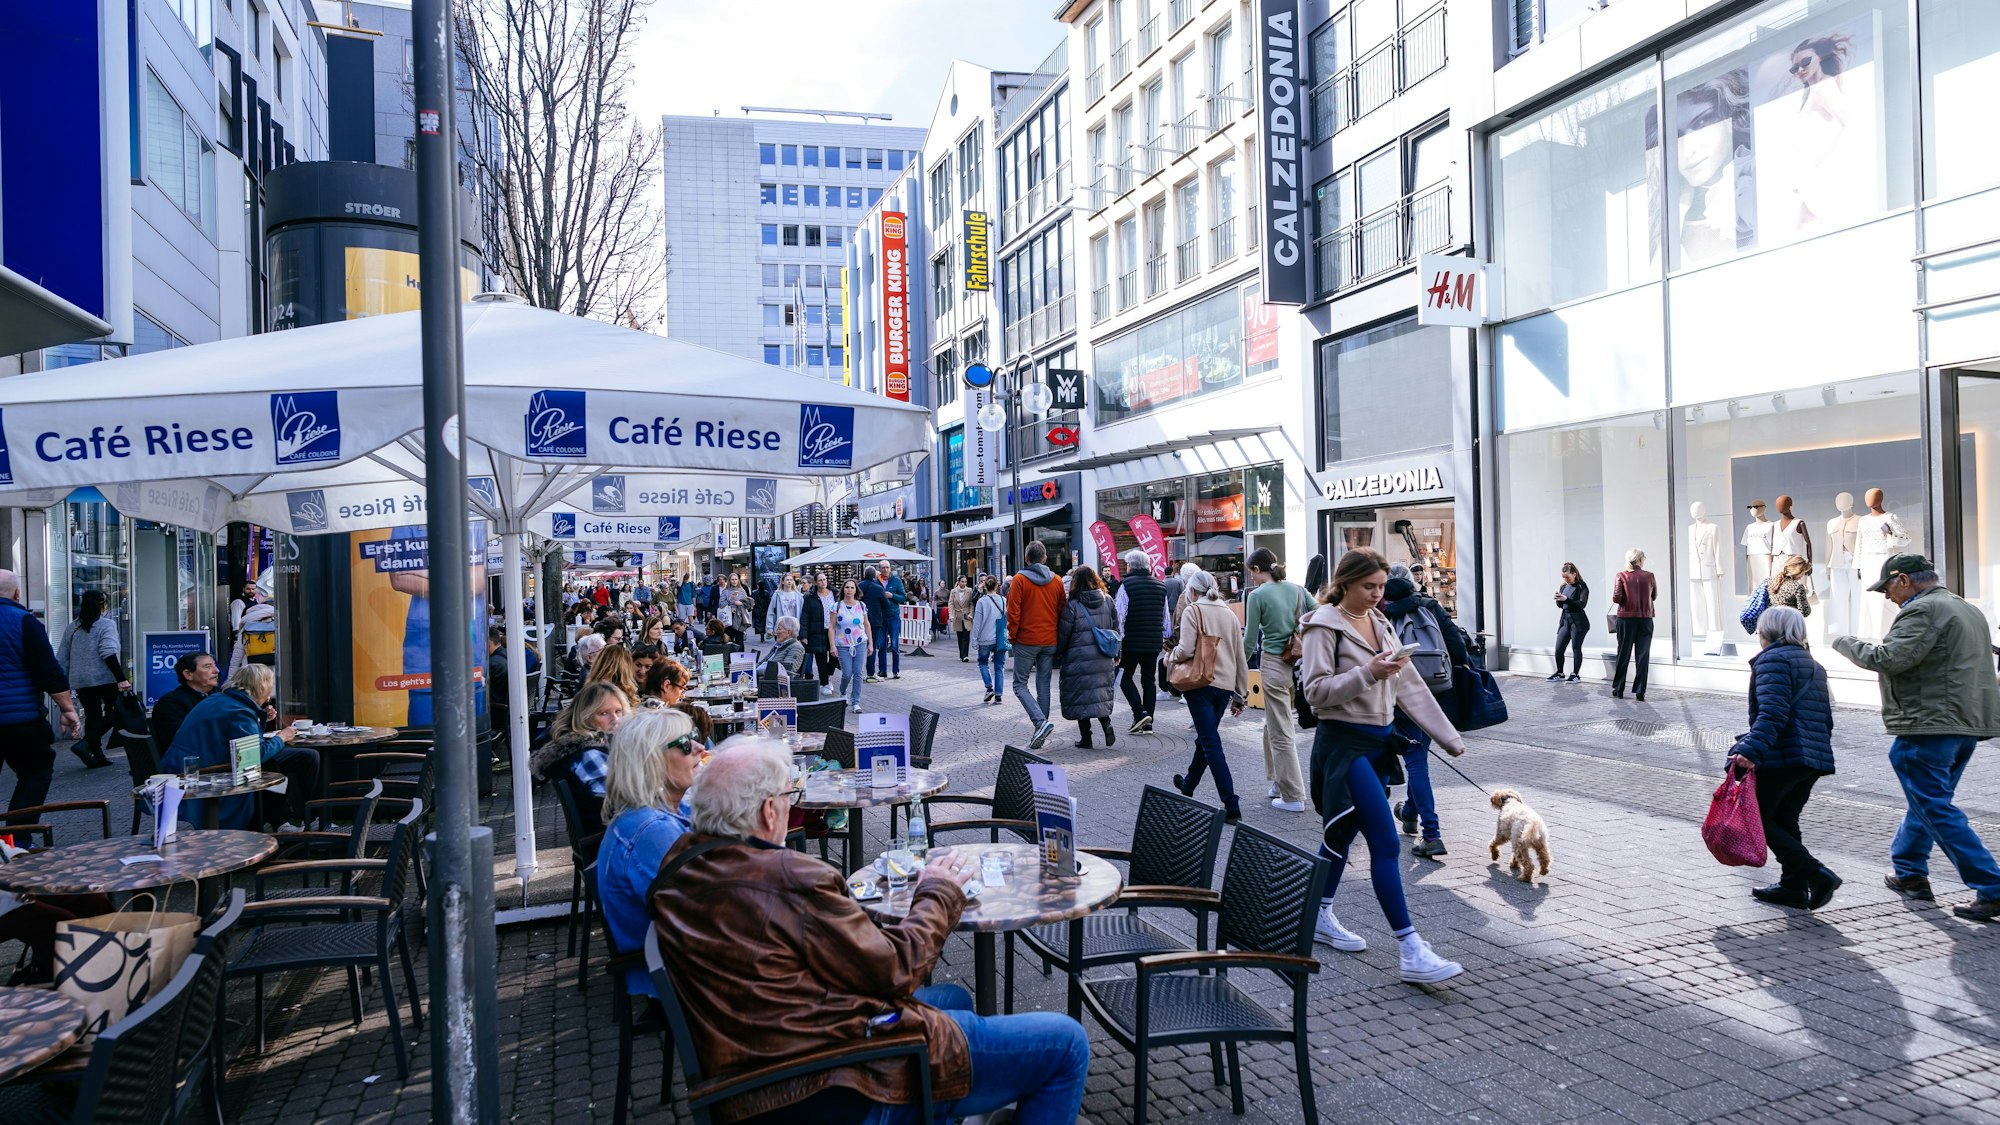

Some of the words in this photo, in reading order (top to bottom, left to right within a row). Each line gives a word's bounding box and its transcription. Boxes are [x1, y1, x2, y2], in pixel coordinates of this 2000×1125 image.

[1268, 10, 1299, 267] CALZEDONIA
[345, 202, 401, 219] STRÖER
[885, 227, 902, 235] KING
[966, 212, 988, 290] Fahrschule
[887, 248, 902, 293] KING
[1427, 270, 1475, 312] H&M
[888, 296, 904, 365] BURGER
[1056, 374, 1077, 403] WMF
[35, 425, 131, 462] Café
[144, 422, 253, 456] Riese
[609, 416, 683, 446] Café
[695, 420, 781, 450] Riese
[289, 450, 307, 460] CAFÉ
[307, 450, 338, 459] COLOGNE
[538, 445, 555, 453] CAFÉ
[555, 446, 585, 454] COLOGNE
[1008, 483, 1044, 505] NRDSEE
[1322, 466, 1444, 500] CALZEDONIA
[584, 521, 612, 534] Café
[616, 522, 651, 534] Riese
[364, 541, 402, 556] Erst
[380, 558, 424, 570] dann
[383, 680, 398, 688] Los
[400, 677, 425, 689] geht's
